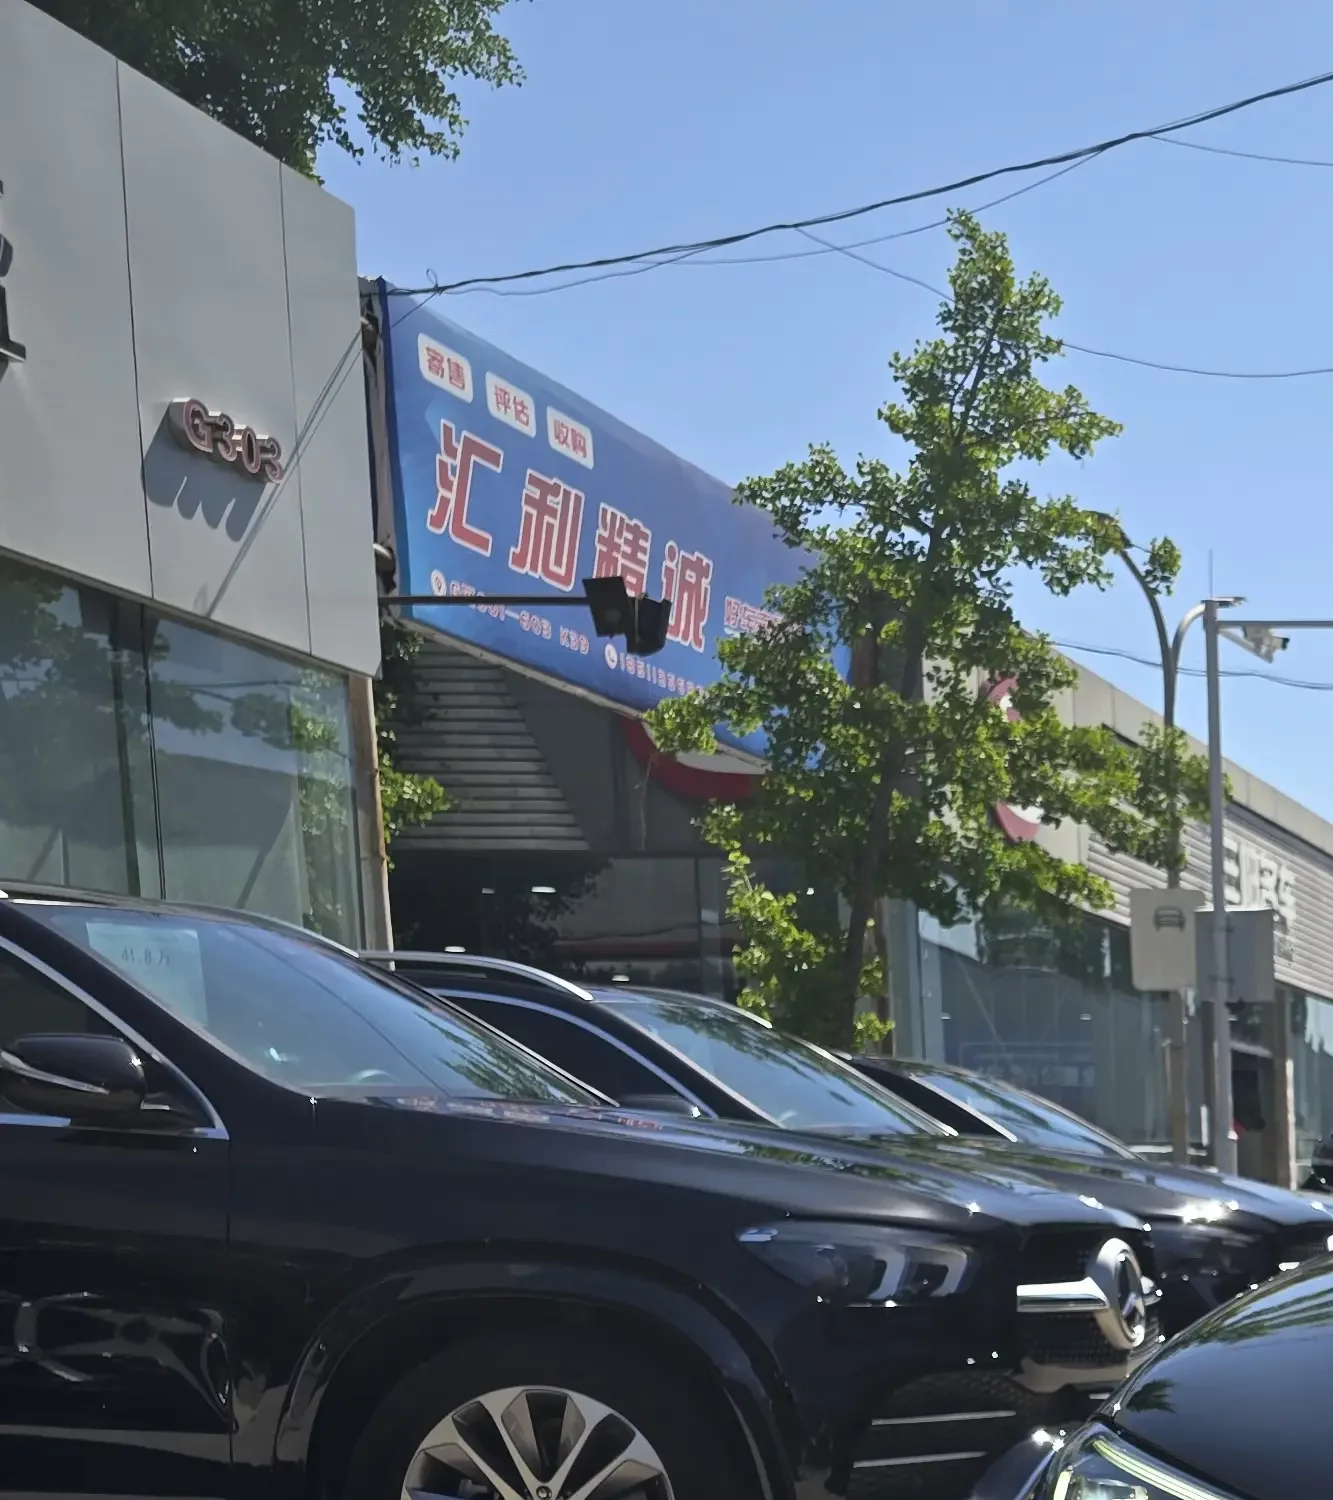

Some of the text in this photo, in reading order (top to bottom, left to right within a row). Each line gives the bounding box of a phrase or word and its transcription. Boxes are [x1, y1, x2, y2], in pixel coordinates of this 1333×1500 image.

[494, 384, 530, 427] 评估
[170, 397, 286, 484] G303
[552, 418, 588, 459] 收购
[427, 418, 714, 652] 汇利精诚
